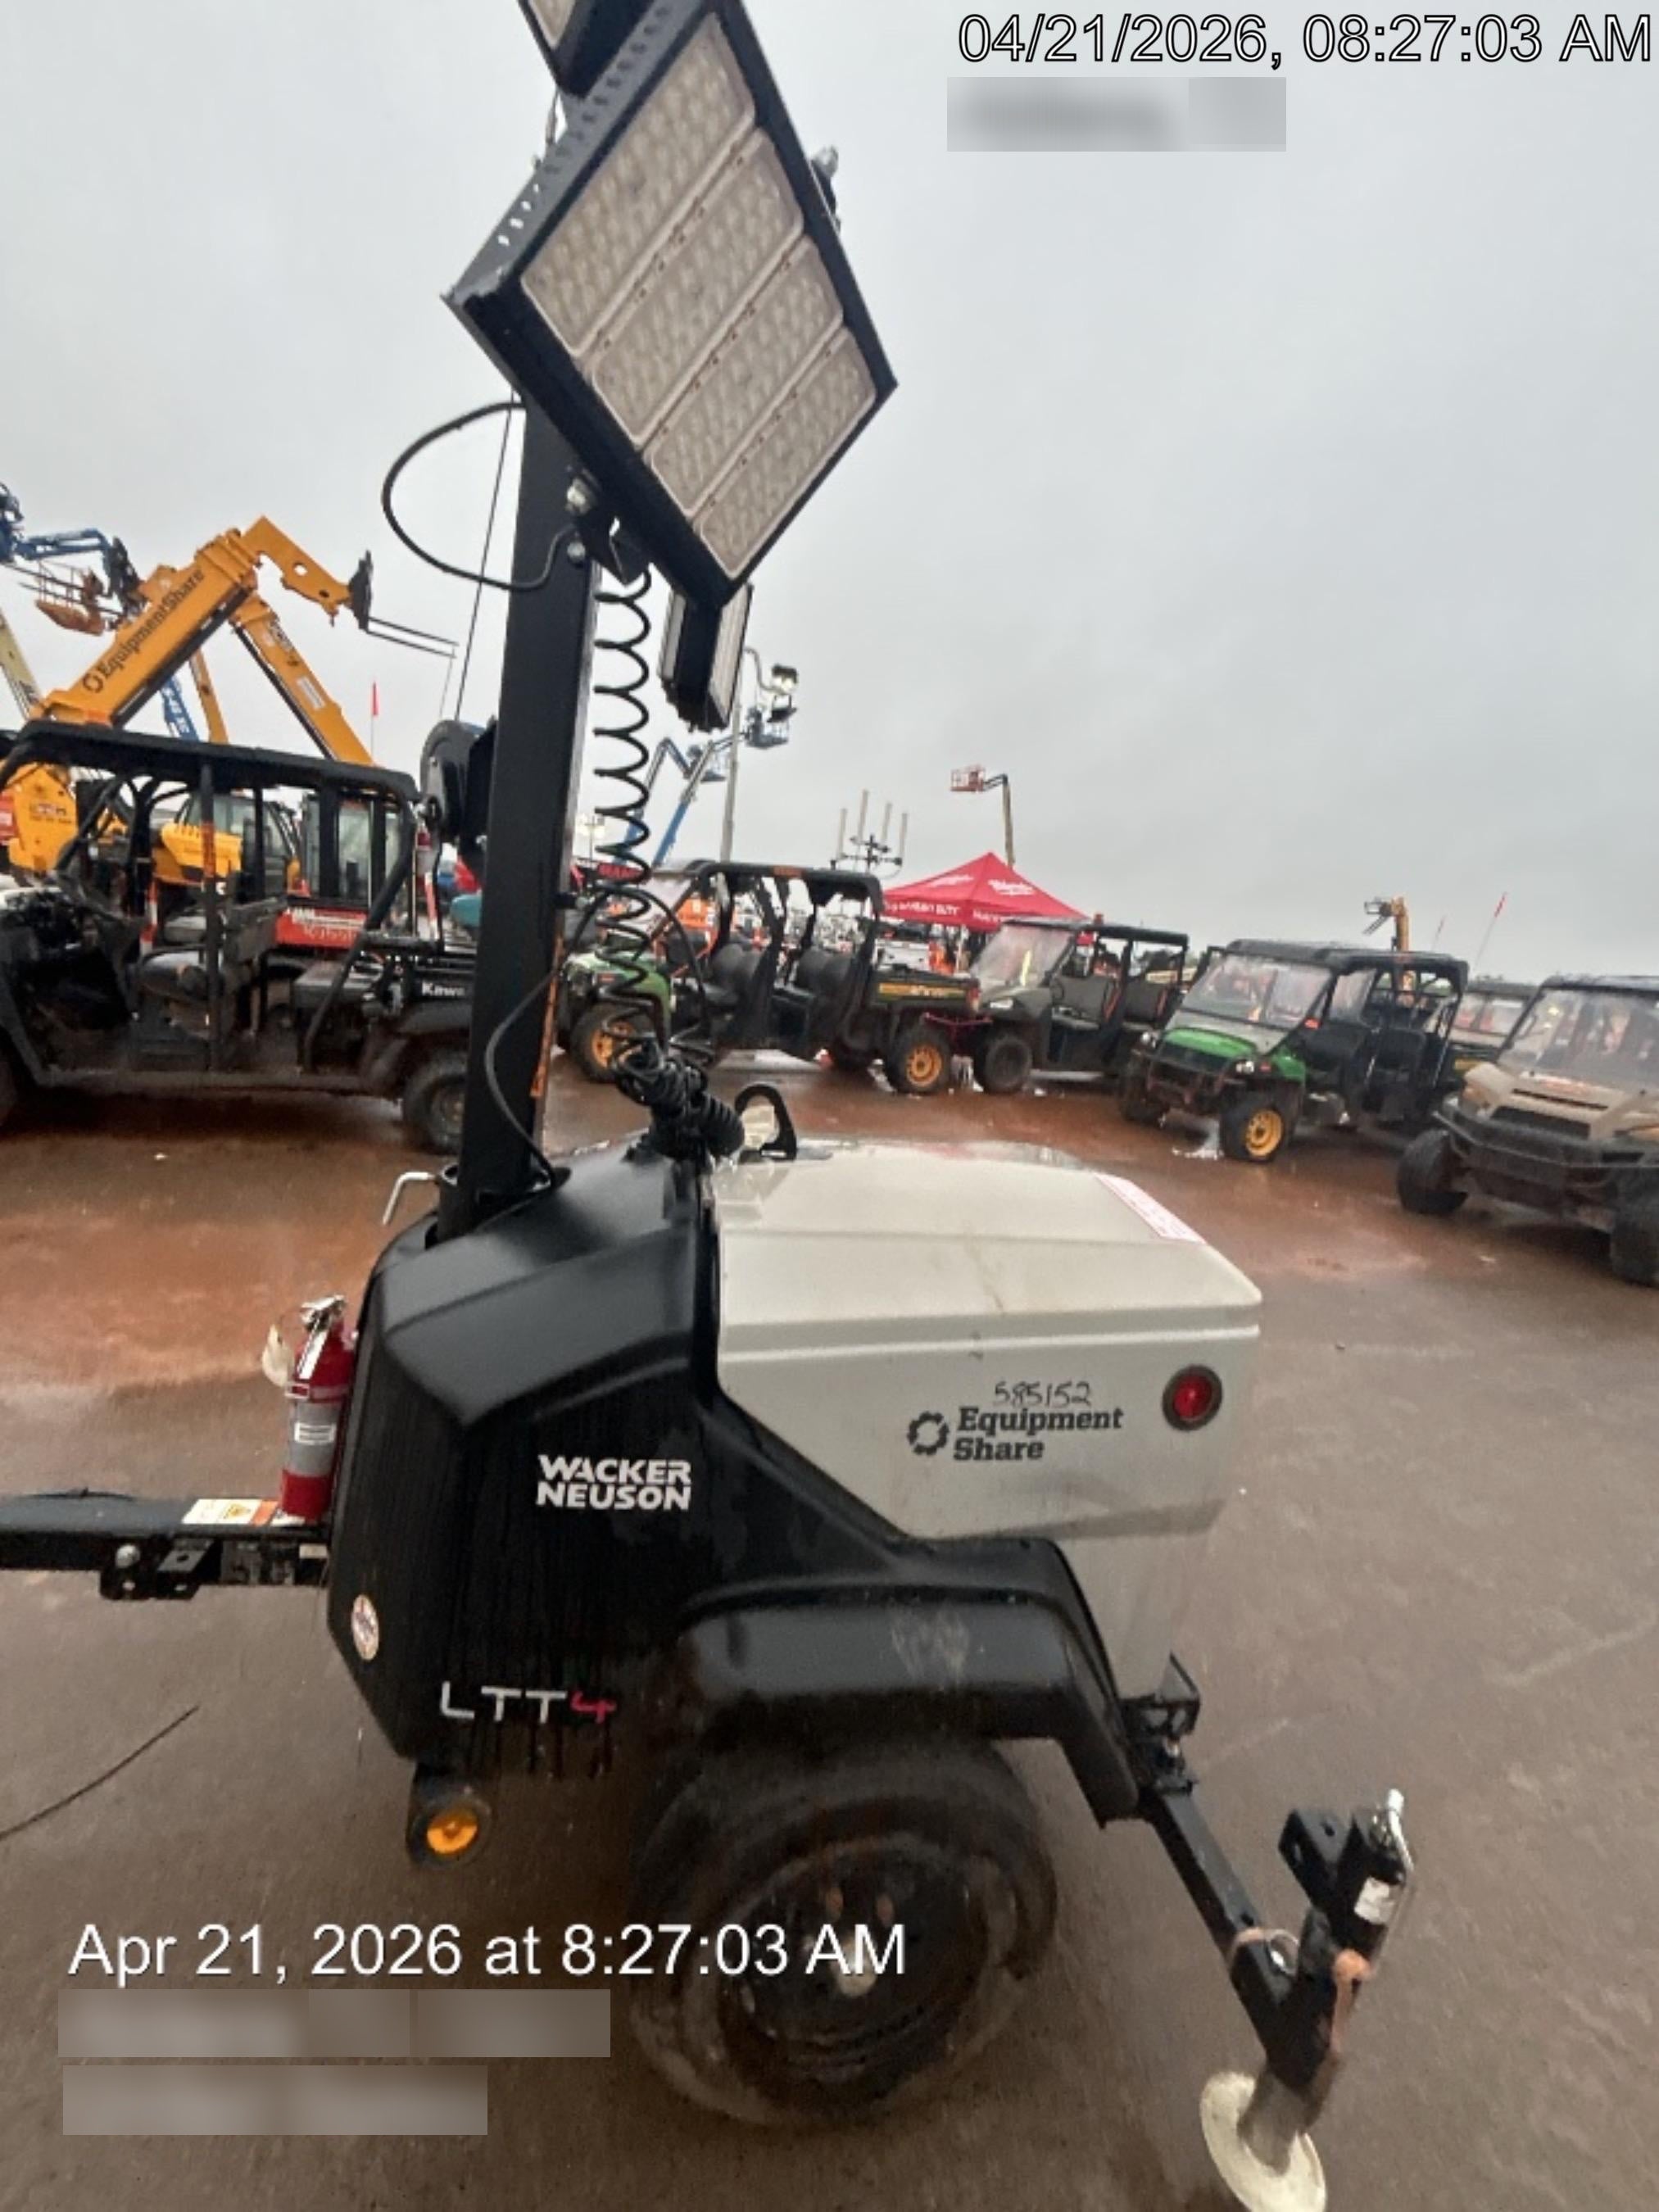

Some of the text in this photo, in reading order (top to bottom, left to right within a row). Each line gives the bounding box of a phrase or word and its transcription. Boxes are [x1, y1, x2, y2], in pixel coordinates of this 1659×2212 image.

[956, 1406, 1124, 1436] Equipment
[953, 1437, 1045, 1462] Share
[537, 1454, 691, 1485] WACKER
[536, 1481, 692, 1511] NEUSON
[439, 1680, 617, 1724] LTT4
